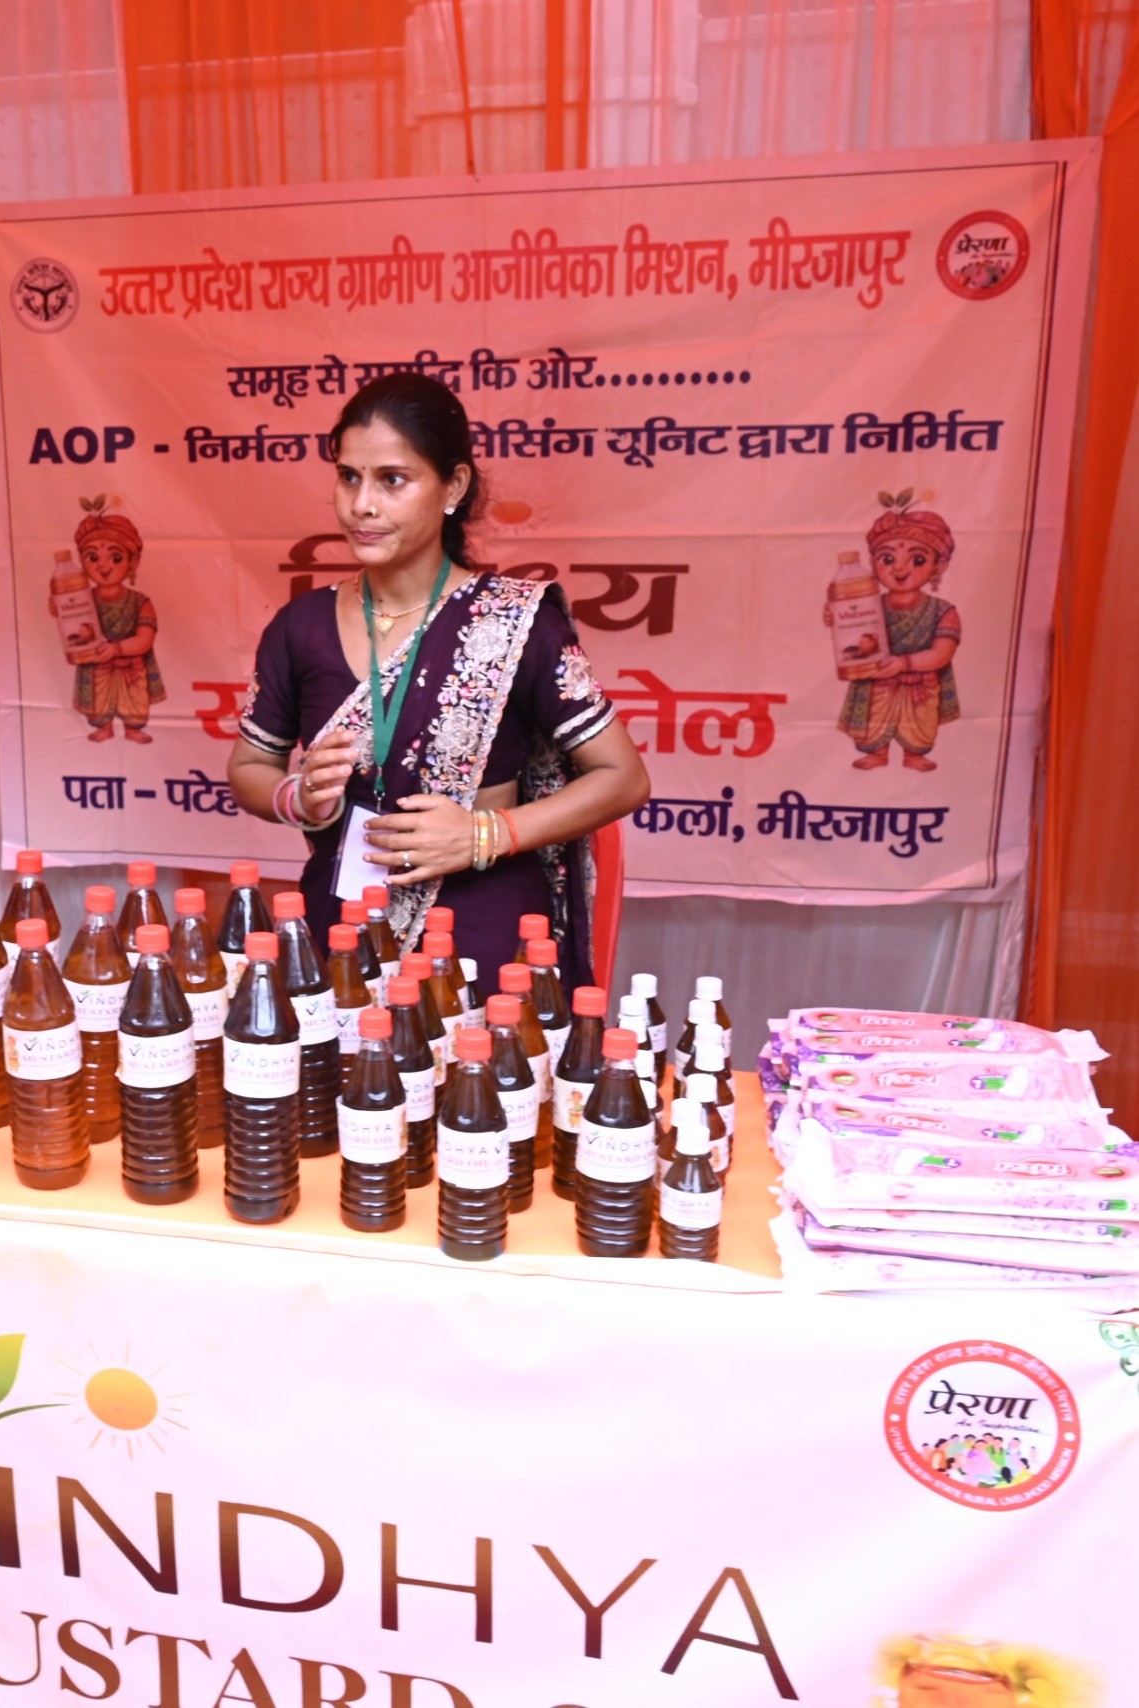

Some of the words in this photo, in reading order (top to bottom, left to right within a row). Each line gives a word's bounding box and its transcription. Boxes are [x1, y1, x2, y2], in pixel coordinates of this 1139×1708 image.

[99, 263, 177, 317] उत्तर
[181, 246, 254, 320] प्रदेश
[260, 257, 332, 313] राज्य
[337, 234, 446, 313] ग्रामीण
[451, 226, 618, 303] आजीविका
[624, 222, 739, 302] मिशन,
[749, 215, 912, 310] मीरजापुर
[227, 365, 312, 409] समूह
[315, 354, 349, 395] से
[470, 348, 520, 391] कि
[30, 425, 136, 465] AOP
[184, 424, 311, 464] निर्मल
[607, 414, 732, 468] यूनिट
[739, 422, 833, 458] द्वारा
[843, 409, 1004, 455] निर्मित
[62, 774, 126, 810] पता
[757, 789, 949, 858] मीरजापुर
[23, 1038, 75, 1052] VINDH
[231, 1053, 295, 1068] VINDHYA
[923, 1379, 1038, 1420] प्रेरणा
